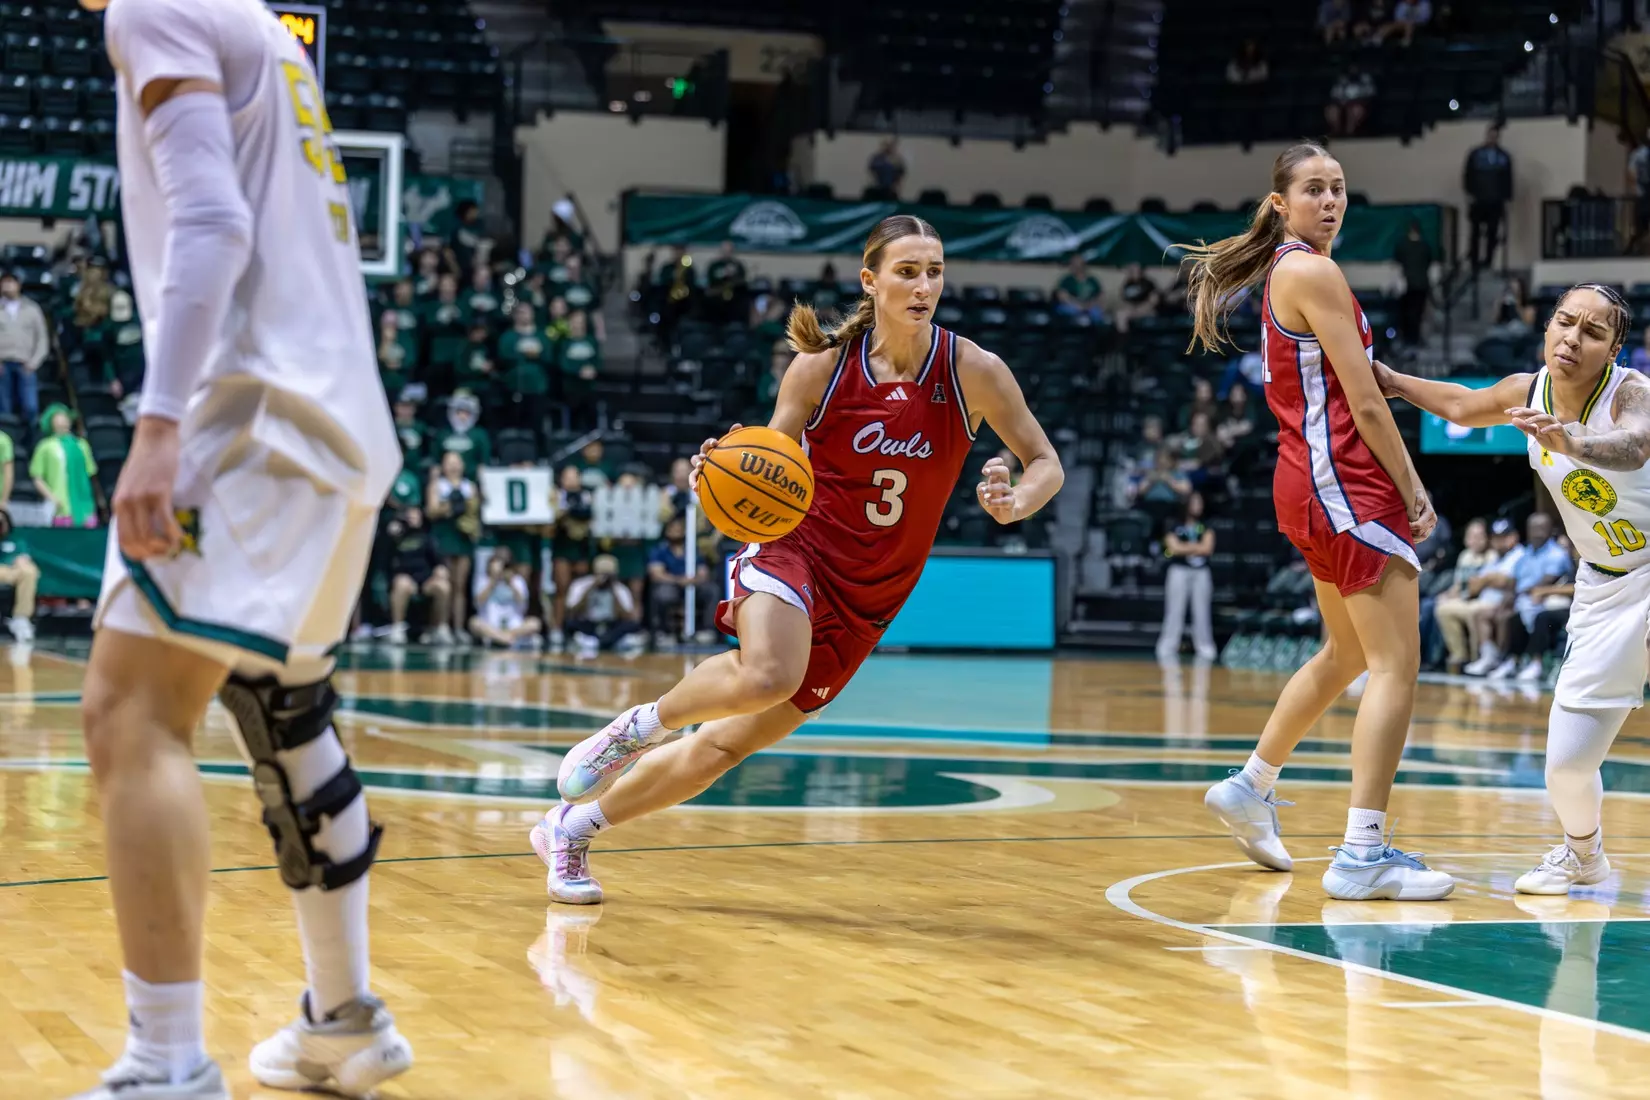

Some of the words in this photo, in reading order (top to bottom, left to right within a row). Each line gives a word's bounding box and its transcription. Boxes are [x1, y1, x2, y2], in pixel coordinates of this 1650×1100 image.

[852, 420, 933, 459] Owls
[507, 478, 529, 514] D
[740, 451, 807, 502] Wilson
[864, 467, 908, 528] 3
[1592, 518, 1647, 557] 10
